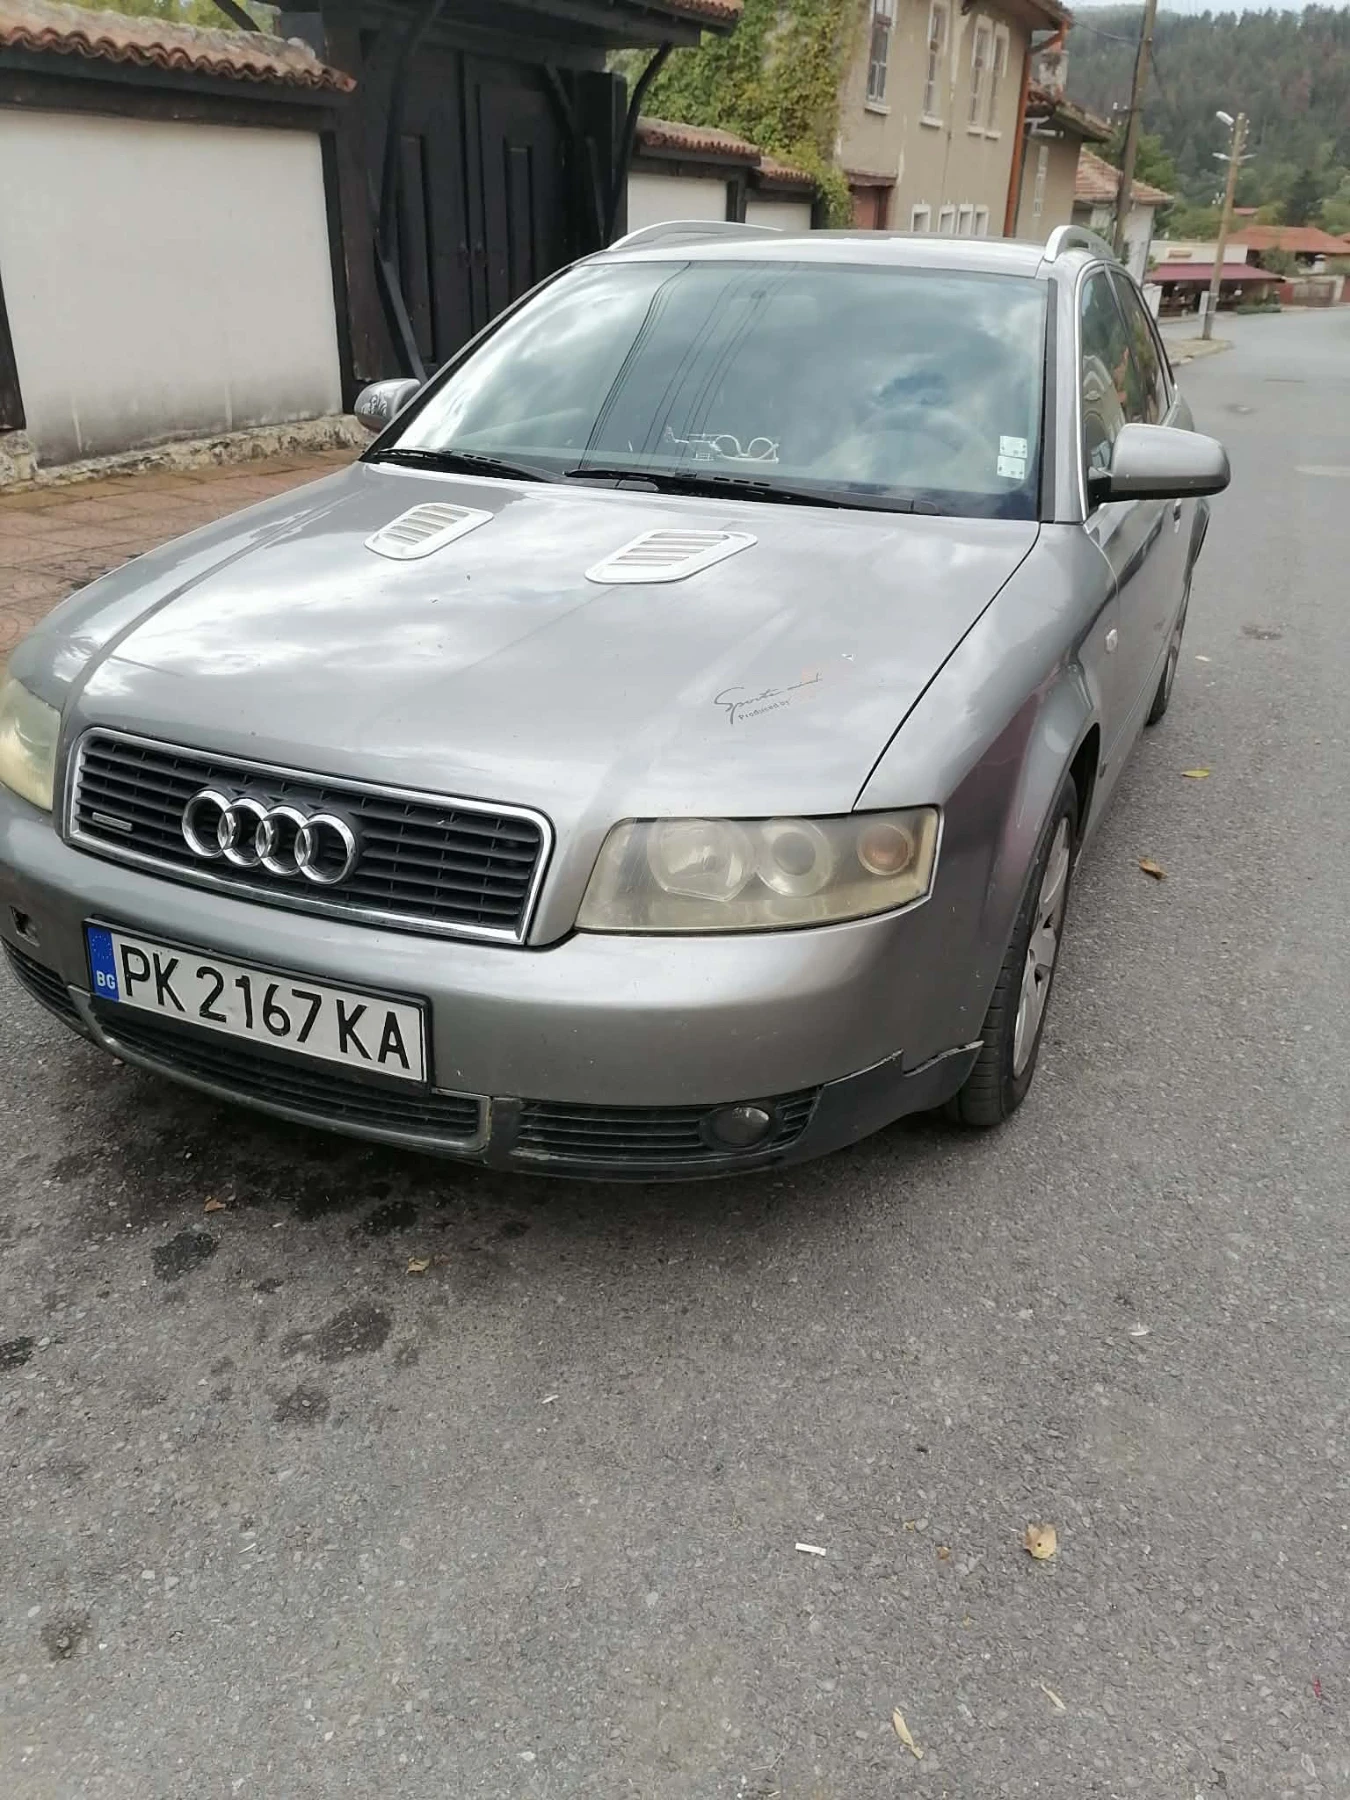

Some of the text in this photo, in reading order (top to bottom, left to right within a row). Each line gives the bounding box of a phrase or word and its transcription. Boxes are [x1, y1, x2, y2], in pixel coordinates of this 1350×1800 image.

[96, 970, 116, 990] BG
[119, 943, 410, 1070] PK 2167 KA
